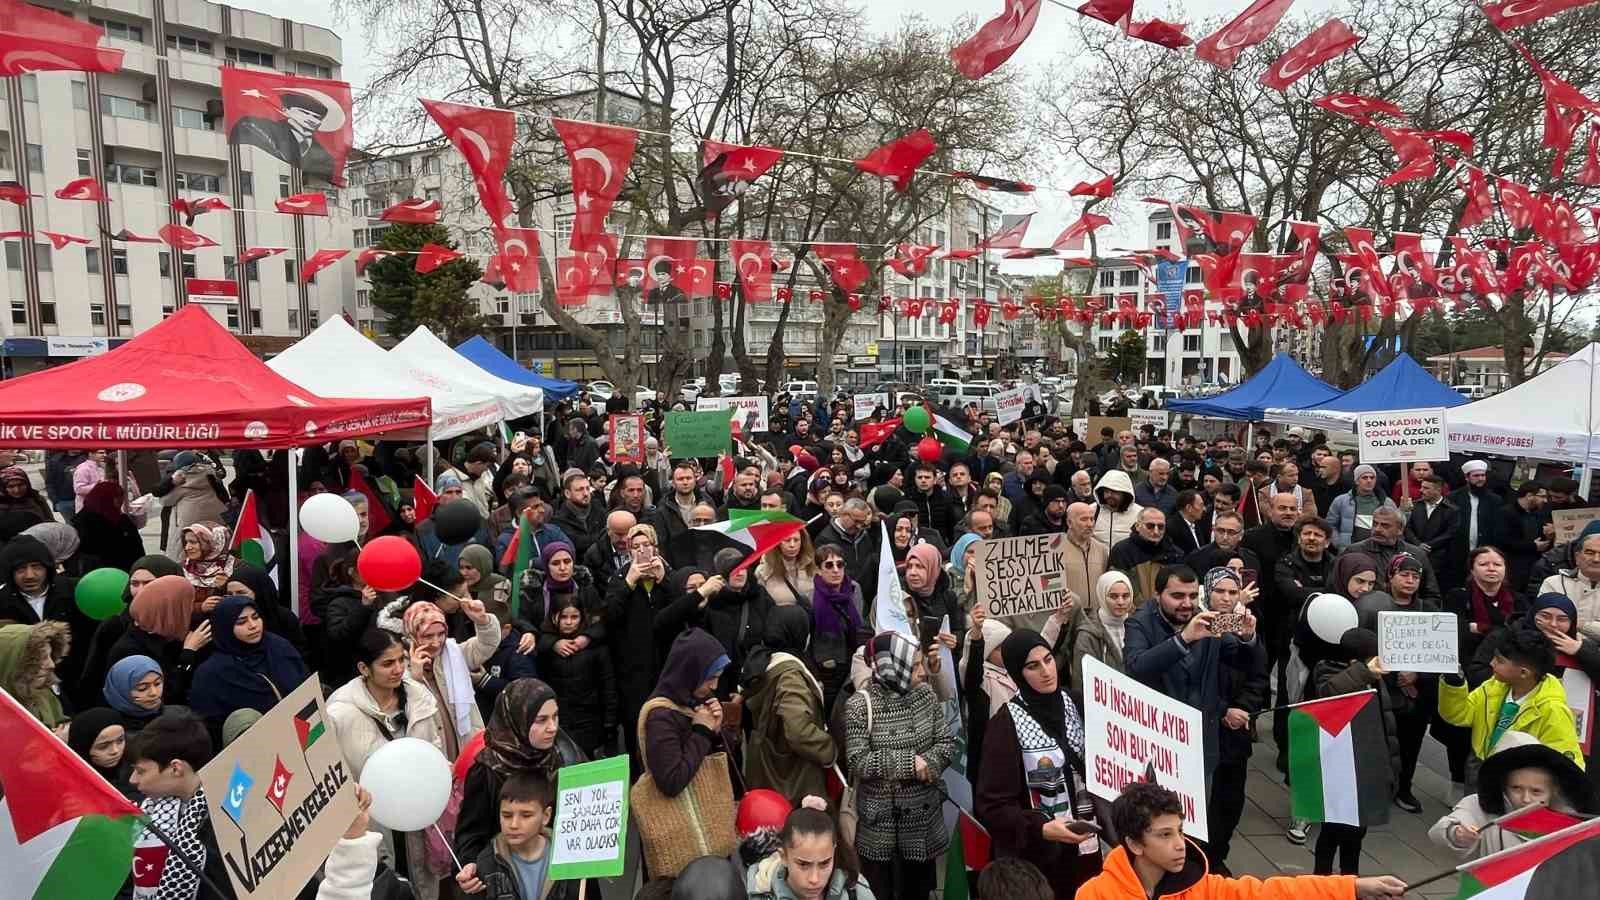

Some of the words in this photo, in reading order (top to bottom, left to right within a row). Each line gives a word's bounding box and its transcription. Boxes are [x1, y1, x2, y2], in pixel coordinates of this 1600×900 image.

[1365, 420, 1387, 428] SON
[1389, 418, 1422, 427] KADIN
[1424, 417, 1439, 425] VE
[22, 426, 43, 440] VE
[47, 425, 93, 440] SPOR
[97, 421, 112, 440] İL
[116, 422, 220, 440] MÜDÜRLÜĞÜ
[1403, 427, 1440, 436] ÖZGÜR
[1371, 439, 1408, 447] OLANA
[1410, 438, 1435, 446] DEK!
[1094, 676, 1107, 707] BU
[1110, 679, 1160, 734] İNSANLIK
[1161, 711, 1190, 746] AYIBI
[1106, 720, 1127, 757] SON
